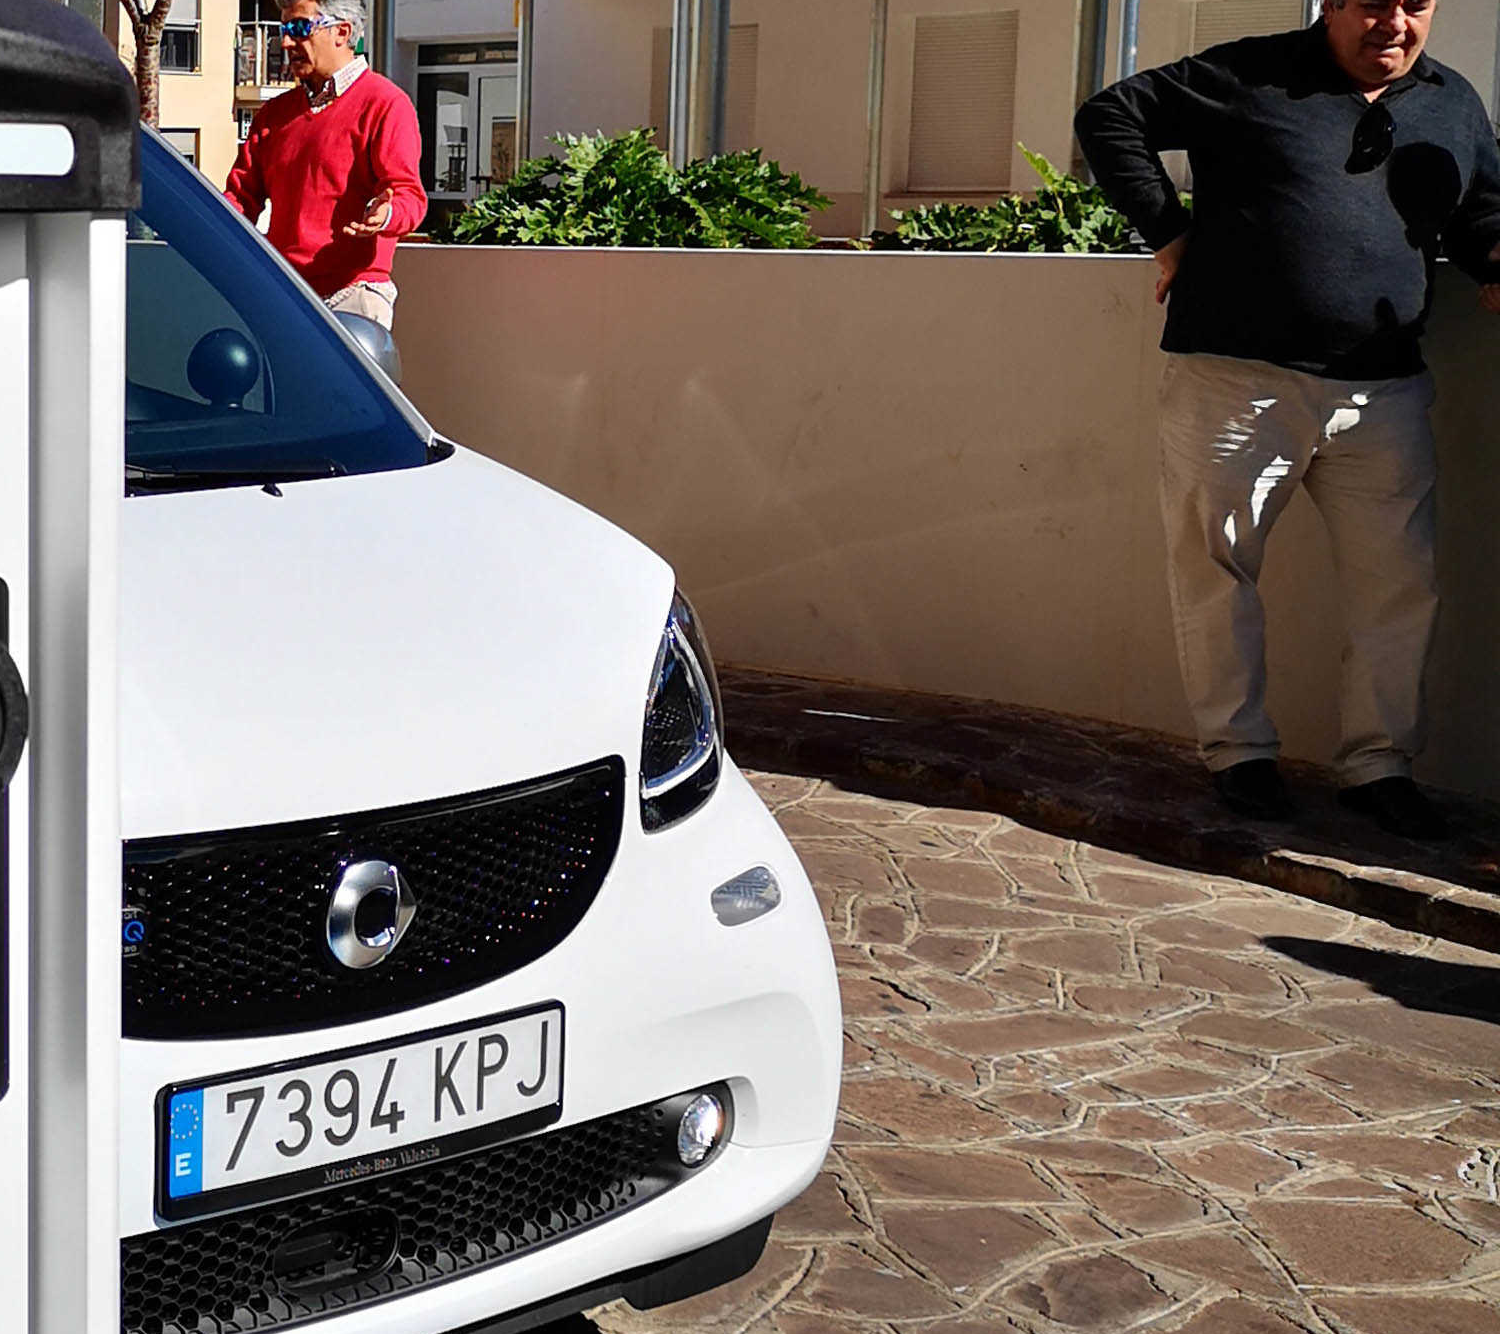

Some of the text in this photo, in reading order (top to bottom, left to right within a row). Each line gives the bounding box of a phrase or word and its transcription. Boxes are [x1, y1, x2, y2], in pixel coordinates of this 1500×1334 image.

[225, 1020, 549, 1172] 7394 KPJ
[175, 1152, 192, 1176] E
